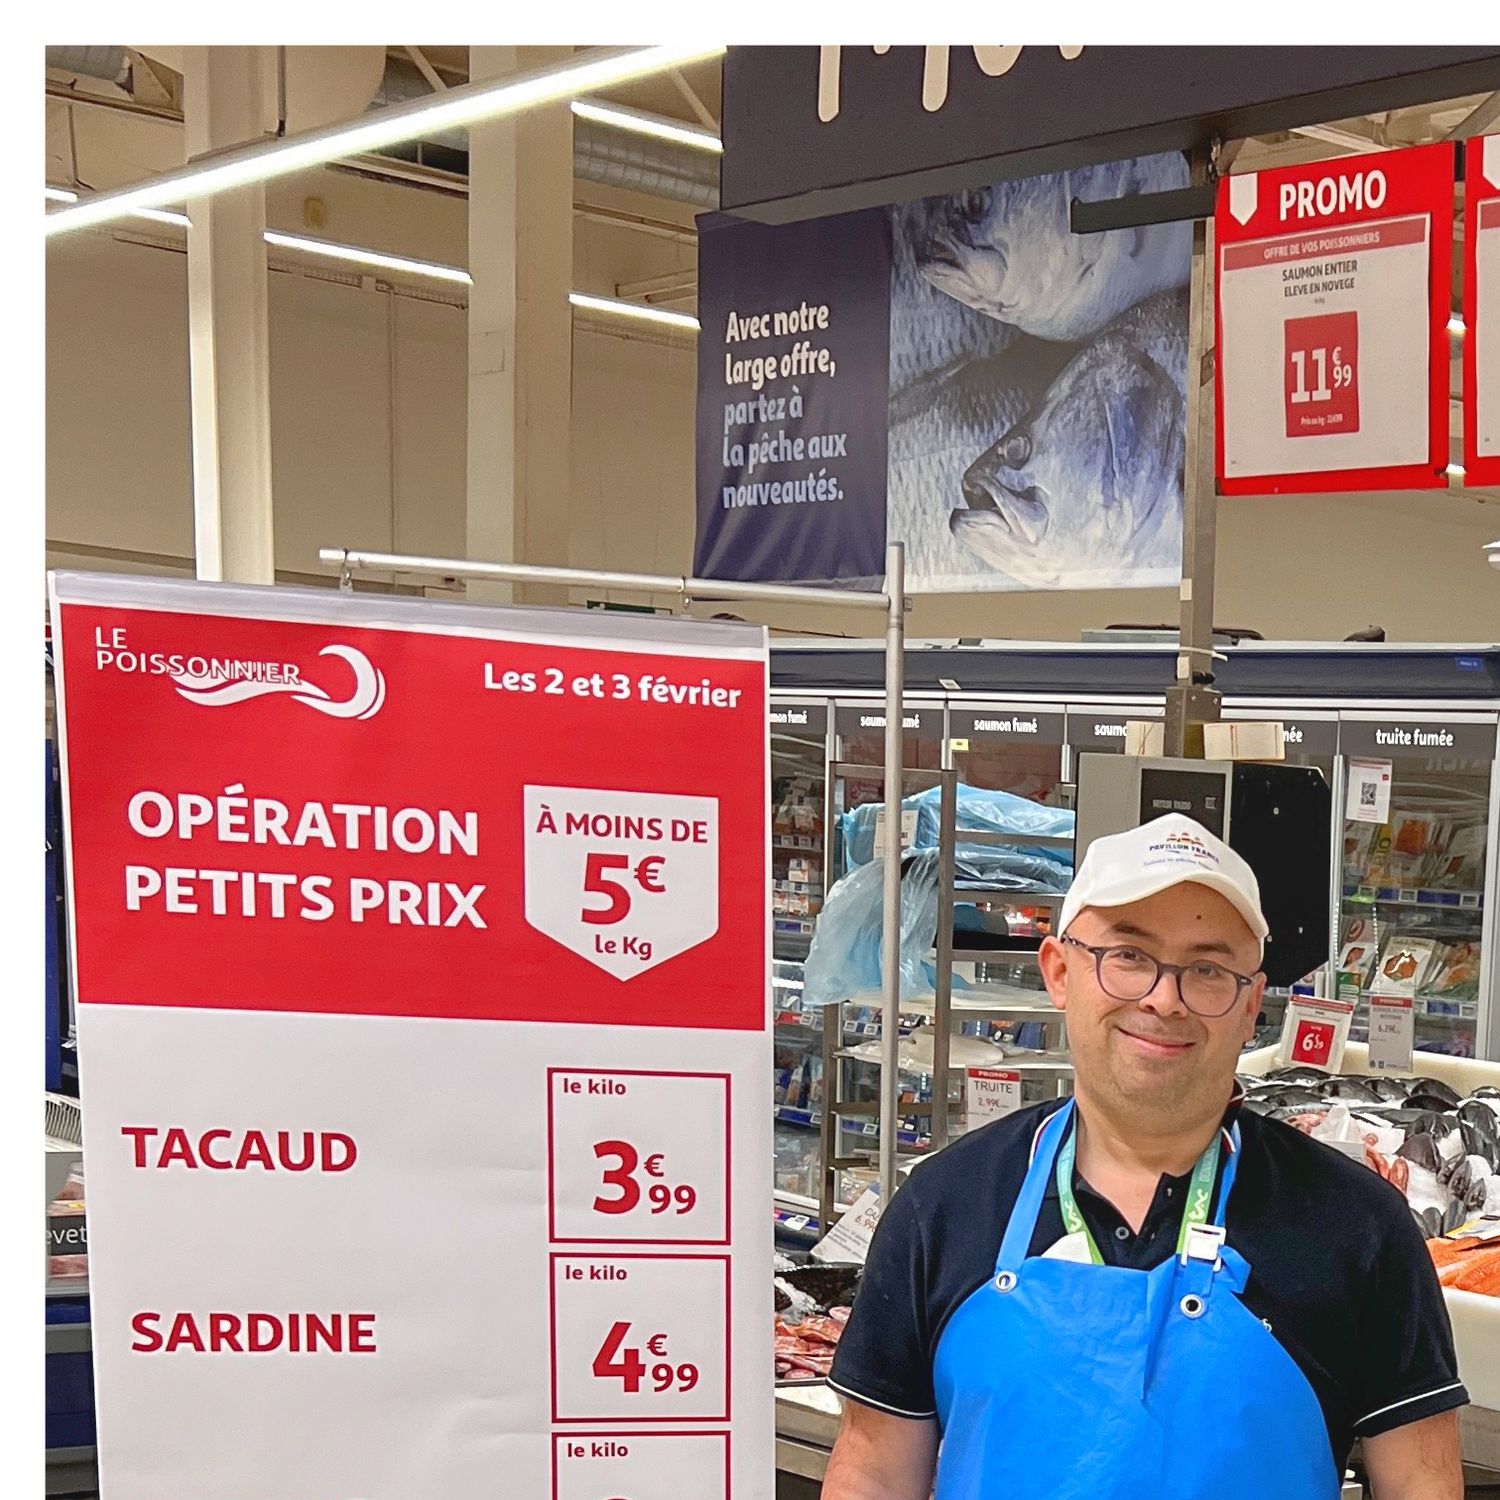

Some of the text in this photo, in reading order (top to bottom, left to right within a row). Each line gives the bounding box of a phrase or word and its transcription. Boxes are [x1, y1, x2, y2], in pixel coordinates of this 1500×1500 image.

[1279, 169, 1387, 221] PROMO
[1319, 231, 1380, 251] POISSONNIERS
[1282, 260, 1358, 282] SAUMON ENTIER
[1284, 282, 1309, 298] ELEVE
[725, 301, 829, 343] Avec notre
[725, 340, 836, 391] large offre,
[724, 385, 803, 435] partez à
[723, 430, 847, 475] la pêche aux
[723, 467, 844, 509] nouveautés.
[95, 627, 127, 648] LE
[96, 650, 302, 687] POISSONNIER
[484, 663, 742, 708] Les 2 et 3 février
[974, 717, 1037, 733] saumon fumé
[1375, 727, 1454, 748] truite fumée
[127, 783, 480, 857] OPÉRATION
[536, 804, 708, 844] À MOINS DE
[125, 867, 487, 929] PETITS PRIX
[581, 853, 665, 925] 5€
[595, 935, 652, 961] le Kg
[563, 1078, 627, 1095] le kilo
[974, 1081, 1013, 1094] TRUITE
[121, 1127, 358, 1172] TACAUD
[565, 1265, 628, 1281] le kilo
[131, 1312, 377, 1353] SARDINE
[567, 1442, 629, 1458] le kilo
